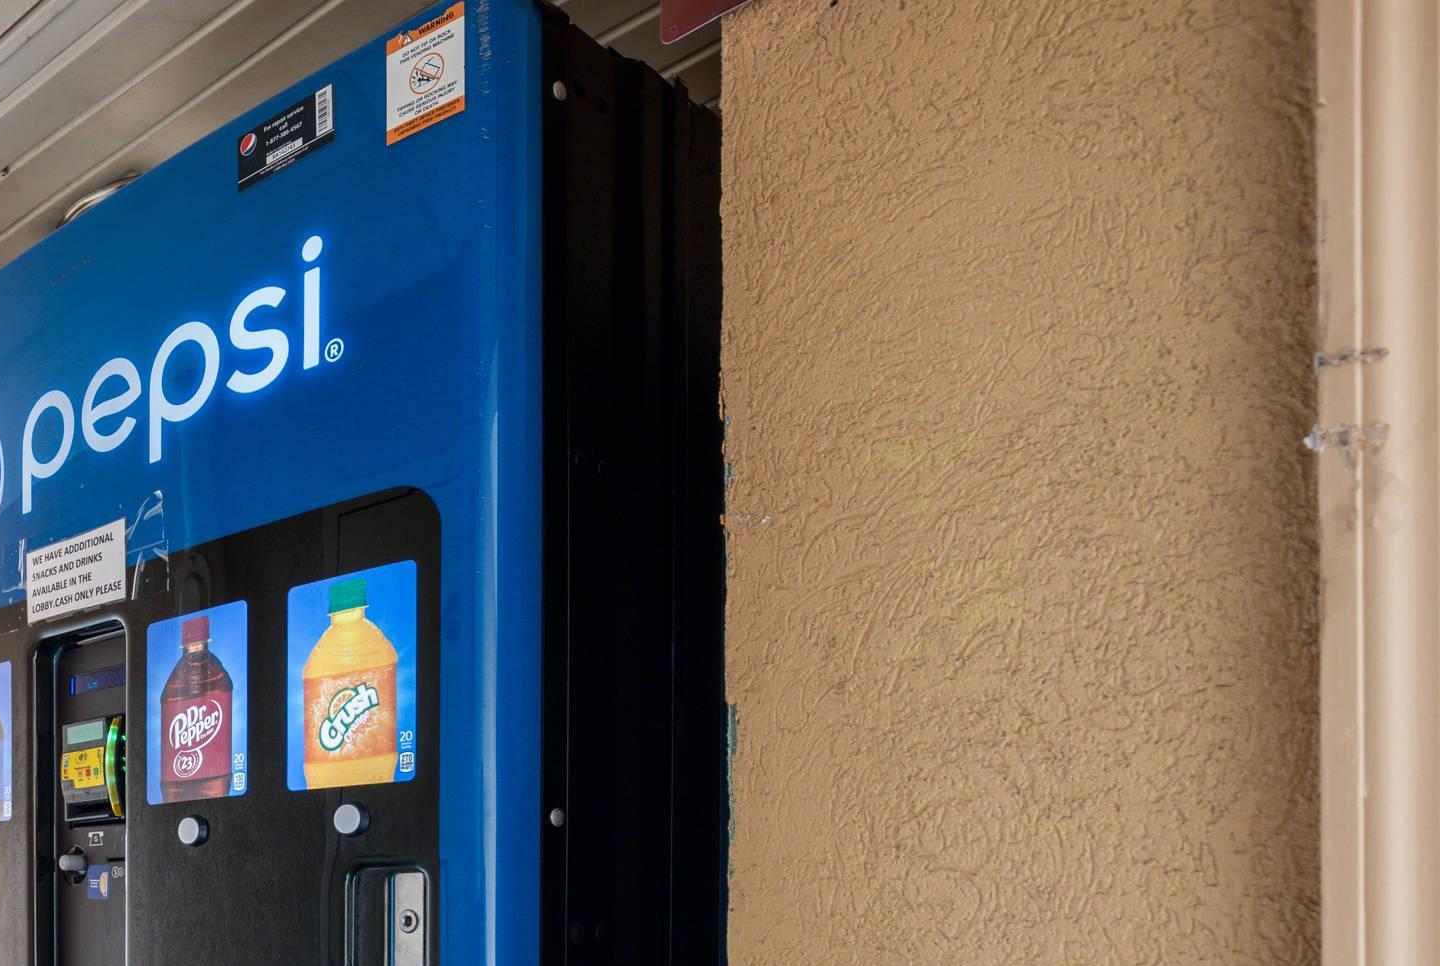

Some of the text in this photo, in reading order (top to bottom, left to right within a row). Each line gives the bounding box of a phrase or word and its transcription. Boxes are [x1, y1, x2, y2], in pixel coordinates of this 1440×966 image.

[272, 116, 286, 128] repair
[287, 106, 304, 119] service
[279, 121, 288, 131] call
[22, 235, 323, 515] pepsi
[32, 532, 114, 566] WE HAVE ADDDITIONAL
[32, 552, 103, 582] SNACKS AND DRINKS
[32, 572, 92, 598] AVAILABLE IN THE
[74, 588, 94, 602] ONLY
[95, 580, 122, 596] PLEASE
[186, 705, 207, 728] Dr
[319, 683, 380, 752] Crush
[399, 730, 413, 742] 20
[181, 756, 192, 770] 23
[233, 753, 245, 764] 20
